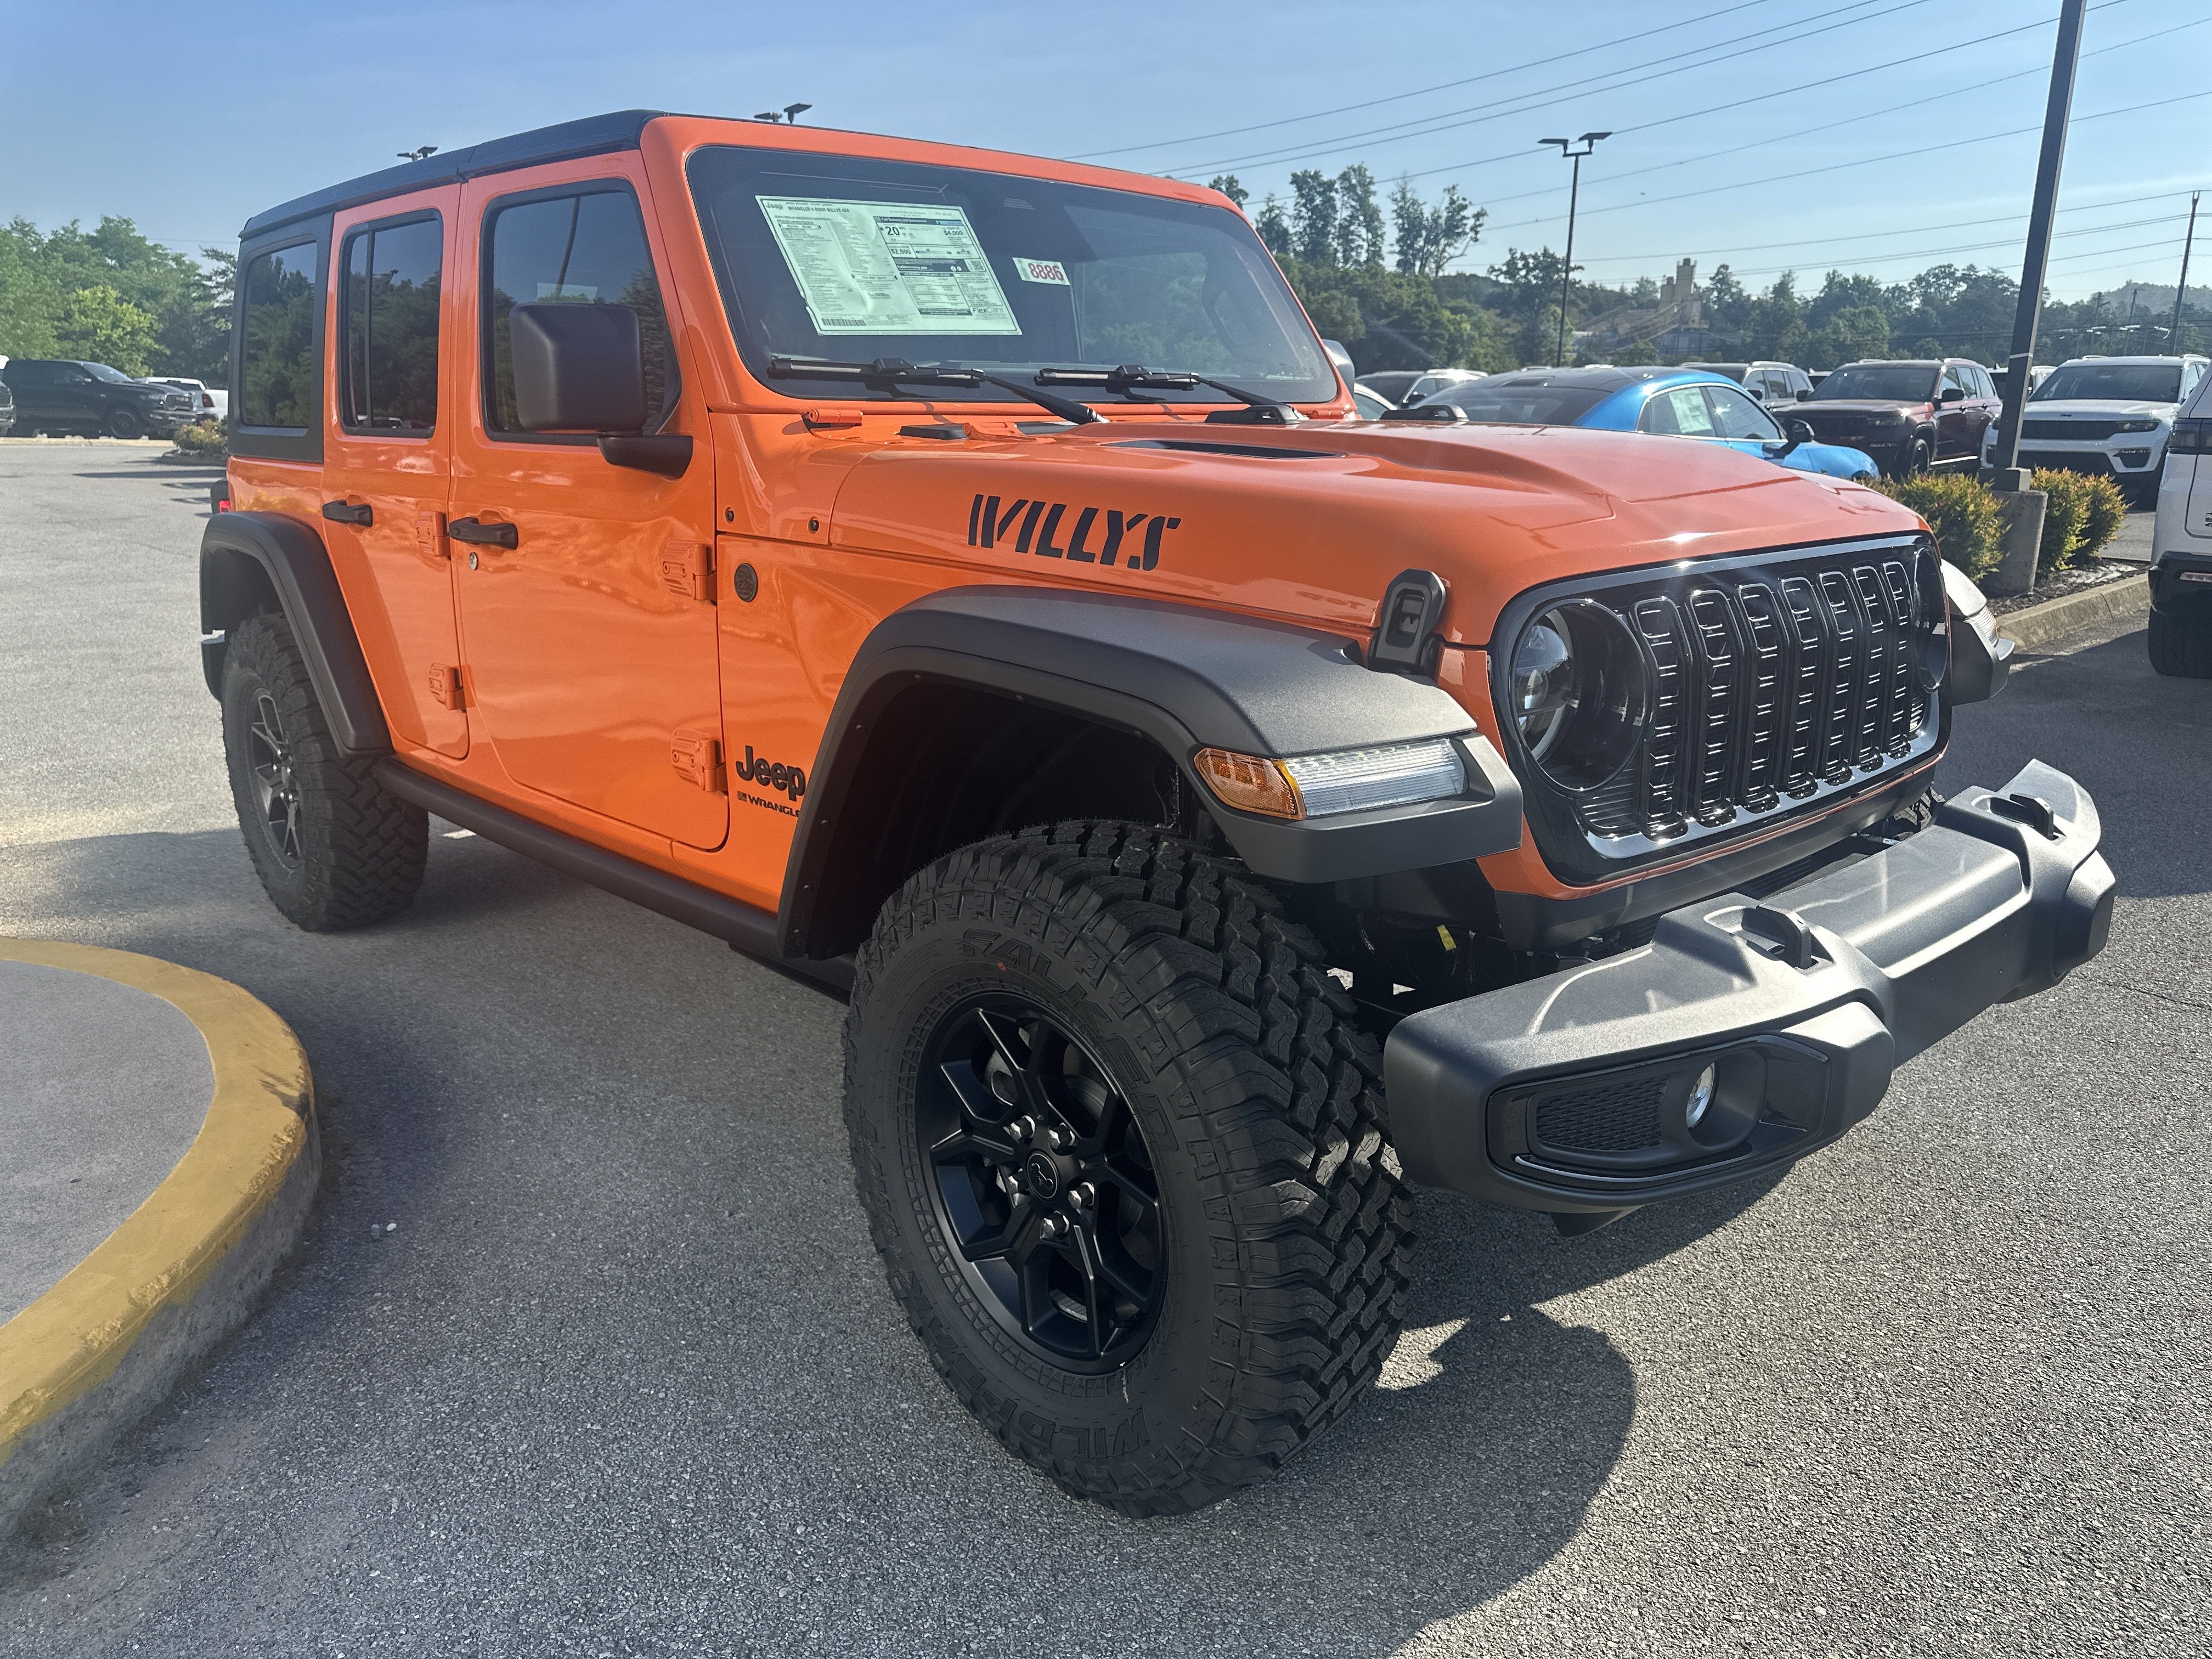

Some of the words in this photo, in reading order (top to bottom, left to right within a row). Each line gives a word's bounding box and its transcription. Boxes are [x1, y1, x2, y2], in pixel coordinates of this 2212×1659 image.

[885, 226, 900, 235] 20
[1029, 263, 1064, 281] 8886
[968, 494, 1181, 571] WILLYS
[736, 745, 806, 802] Jeep
[907, 1271, 1151, 1459] WILDPEAK
